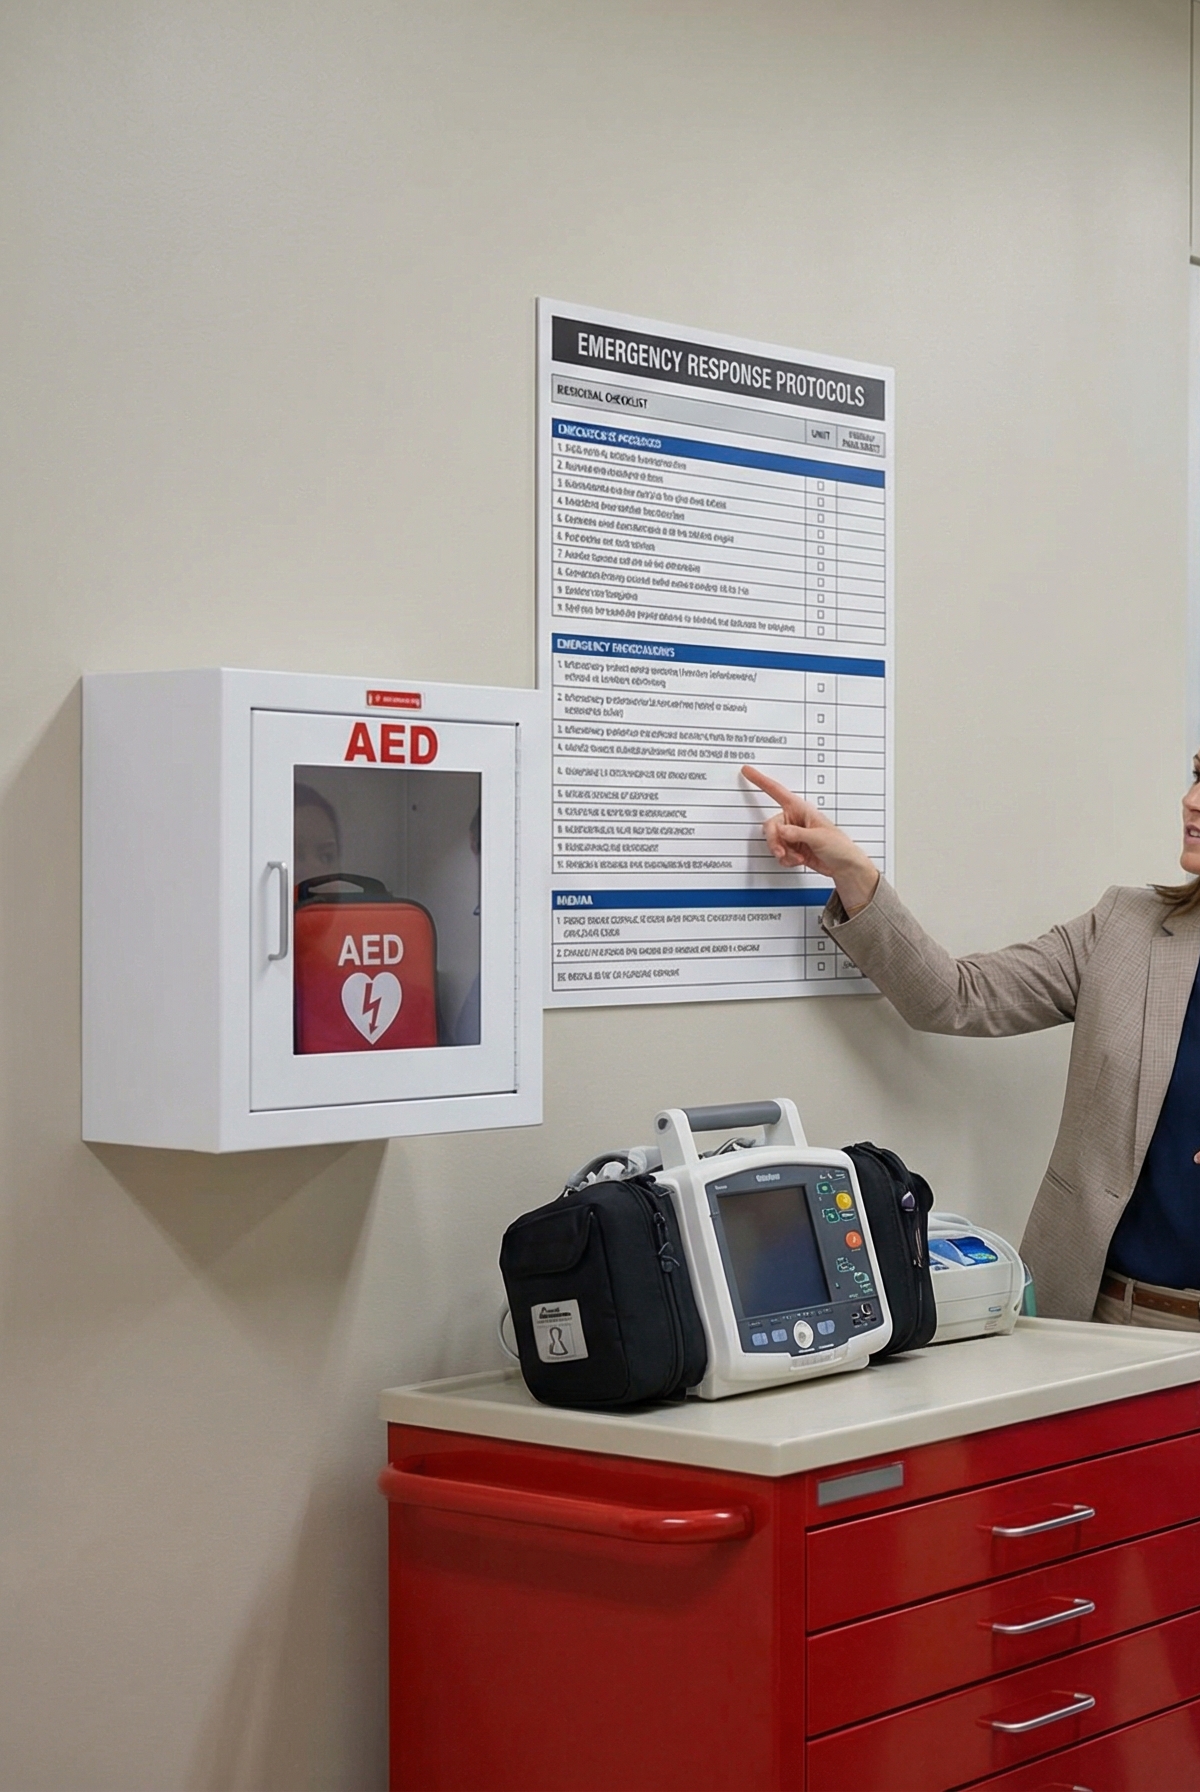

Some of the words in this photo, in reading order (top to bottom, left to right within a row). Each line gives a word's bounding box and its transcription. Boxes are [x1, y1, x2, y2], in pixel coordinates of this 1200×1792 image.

[577, 332, 683, 373] EMERGENCY
[687, 353, 772, 390] RESPONSE
[776, 371, 865, 407] PROTOCOLS
[344, 722, 439, 765] AED
[338, 934, 404, 967] AED
